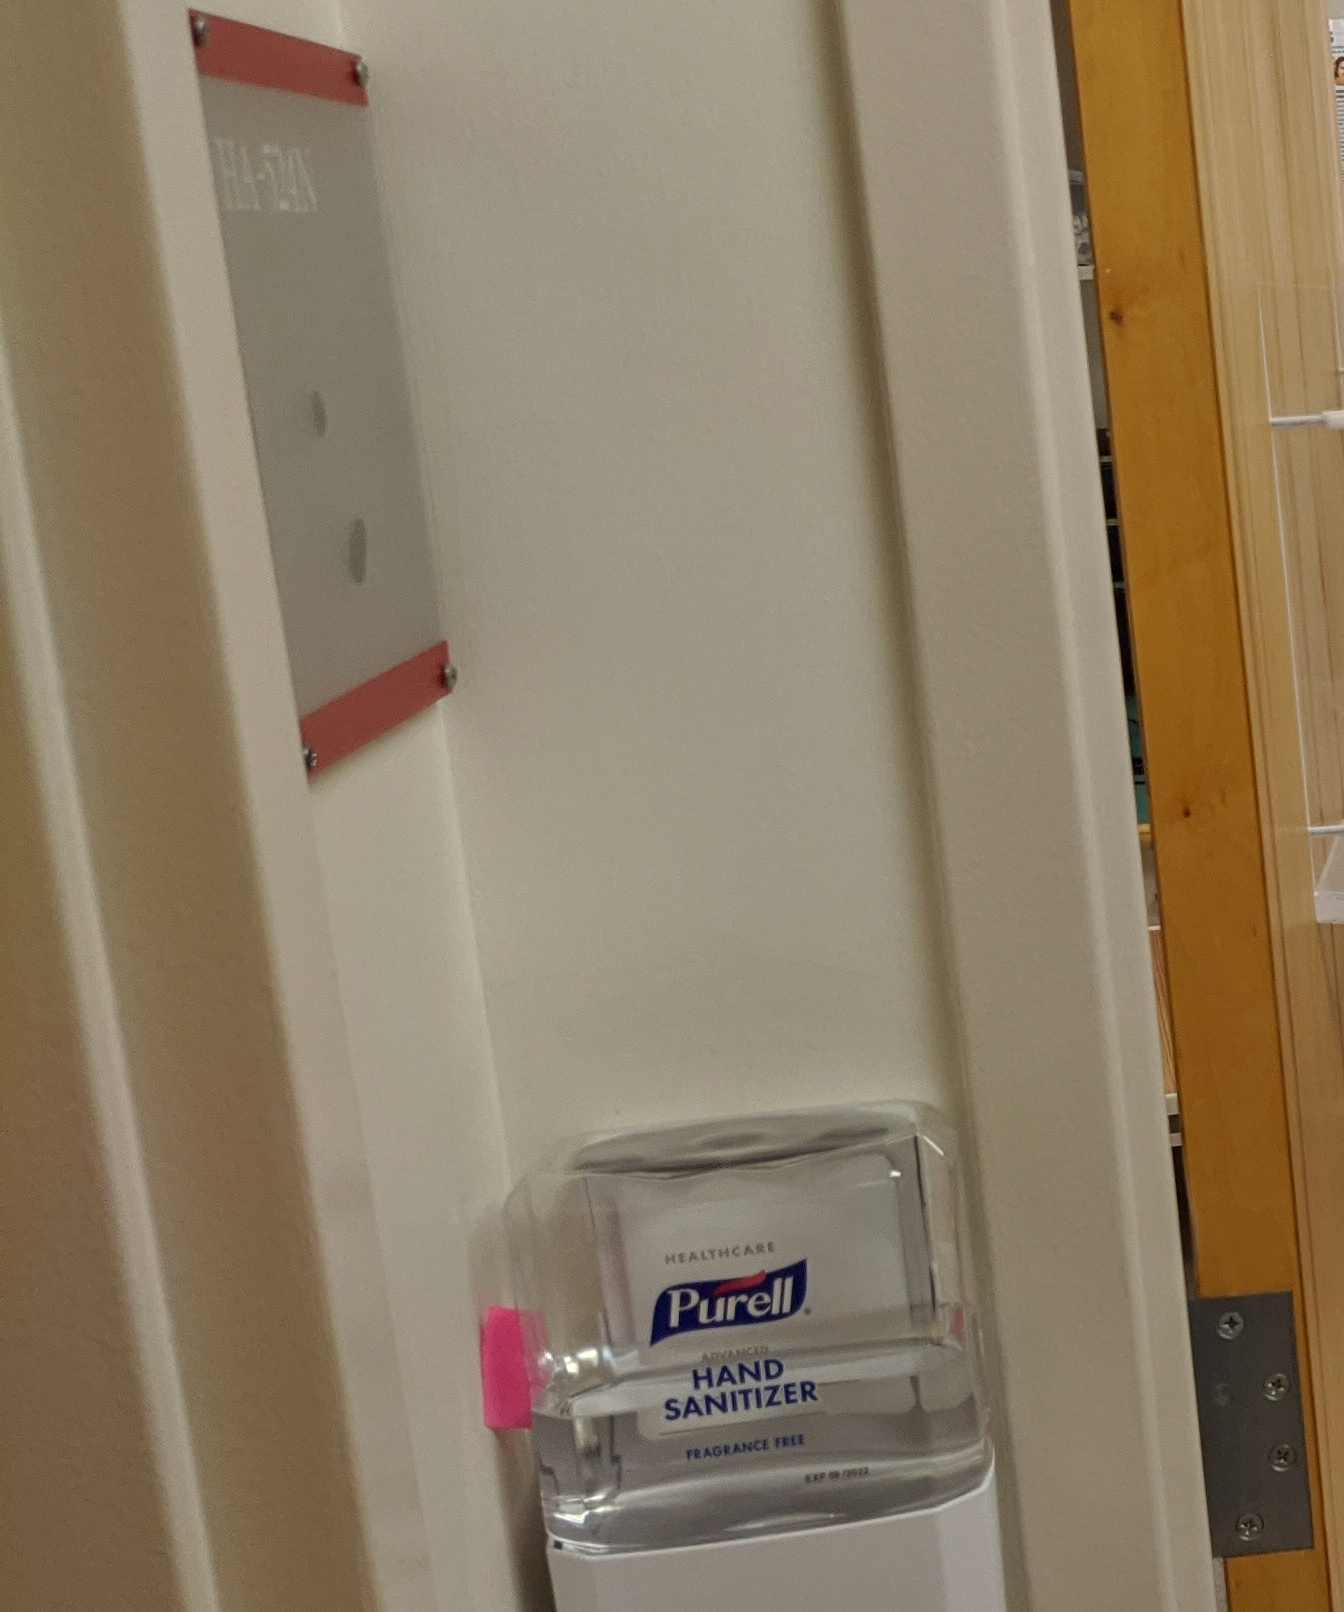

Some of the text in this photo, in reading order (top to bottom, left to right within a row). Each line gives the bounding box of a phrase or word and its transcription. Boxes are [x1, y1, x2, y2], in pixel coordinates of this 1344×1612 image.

[665, 1241, 776, 1265] HEALTHCARE
[667, 1275, 794, 1328] Purell
[702, 1345, 769, 1362] ADVANCED
[692, 1358, 784, 1391] HAND
[664, 1380, 819, 1421] SANITIZER
[686, 1433, 805, 1460] FRAGRANCE FREE
